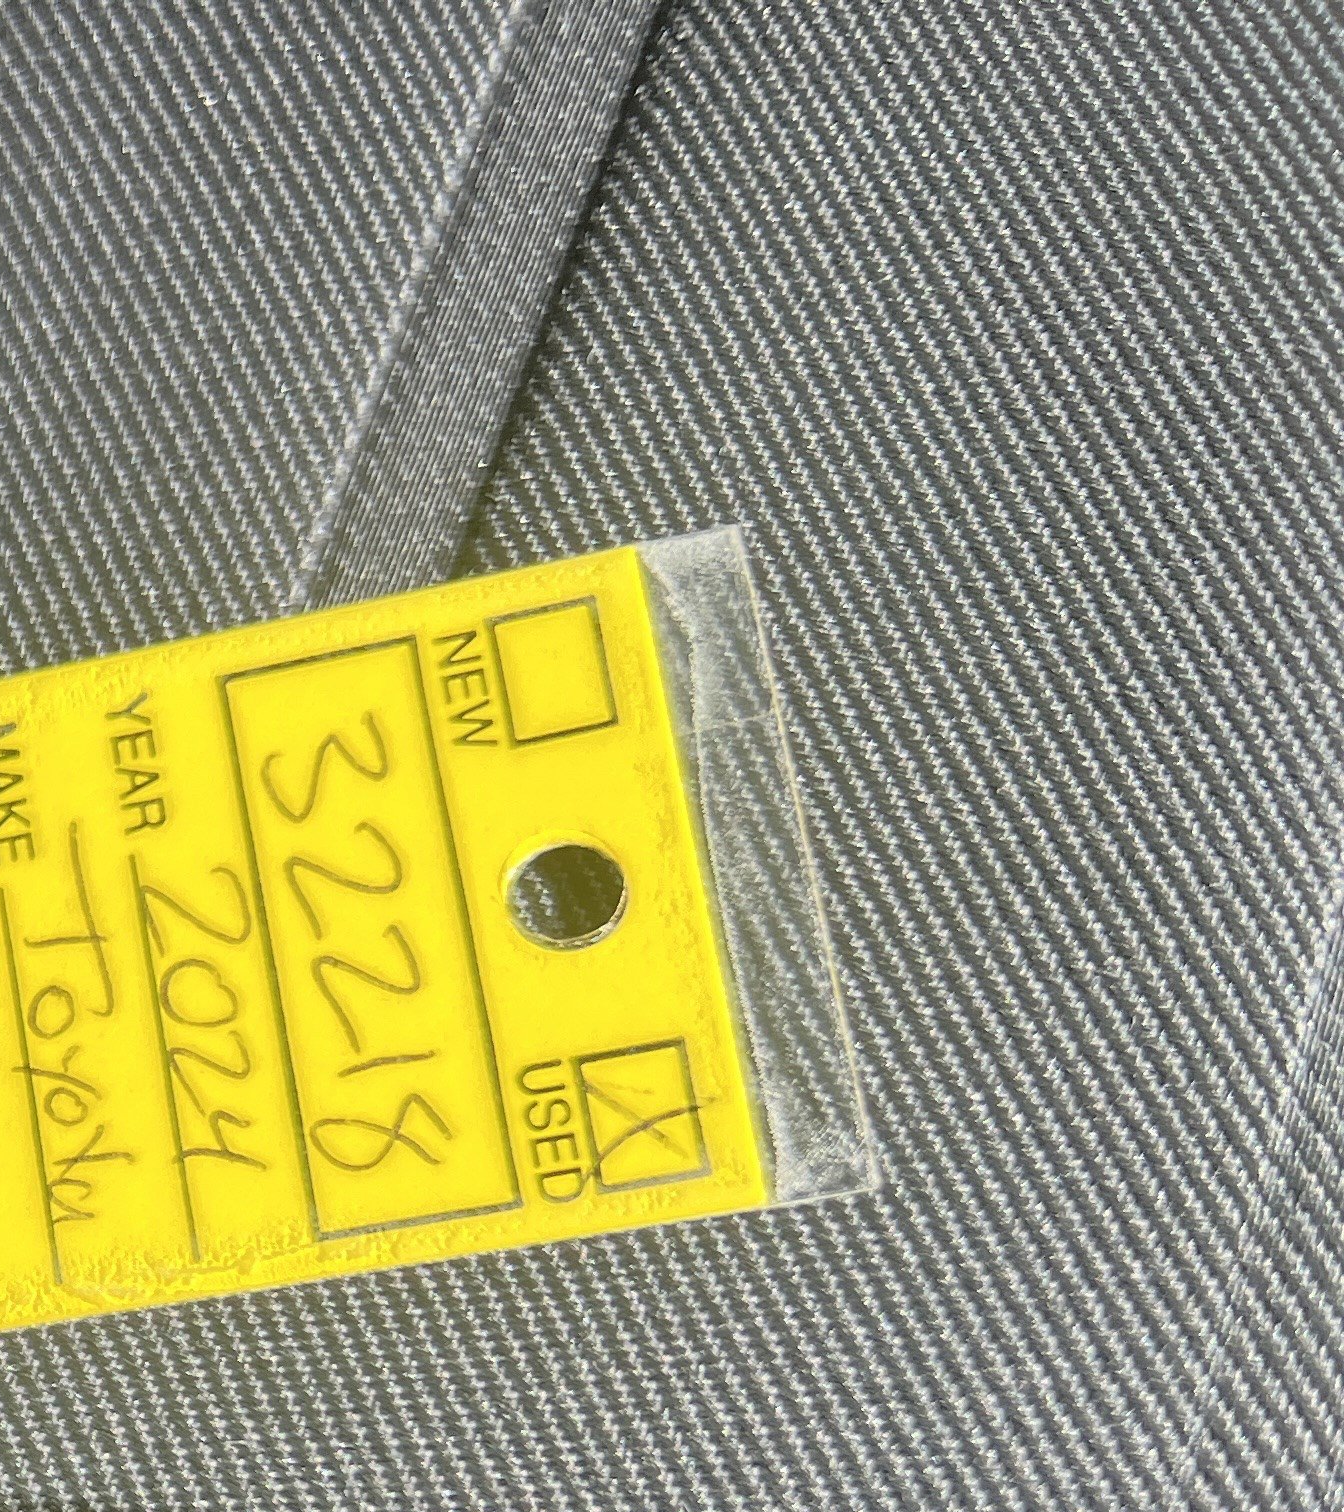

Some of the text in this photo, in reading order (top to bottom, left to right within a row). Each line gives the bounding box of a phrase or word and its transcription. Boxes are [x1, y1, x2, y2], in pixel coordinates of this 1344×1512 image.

[105, 691, 167, 837] YEAR
[434, 629, 499, 749] NEW
[12, 822, 134, 1224] Toyota
[140, 866, 267, 1172] 2024
[260, 710, 454, 1173] 32218
[517, 1058, 587, 1203] USED
